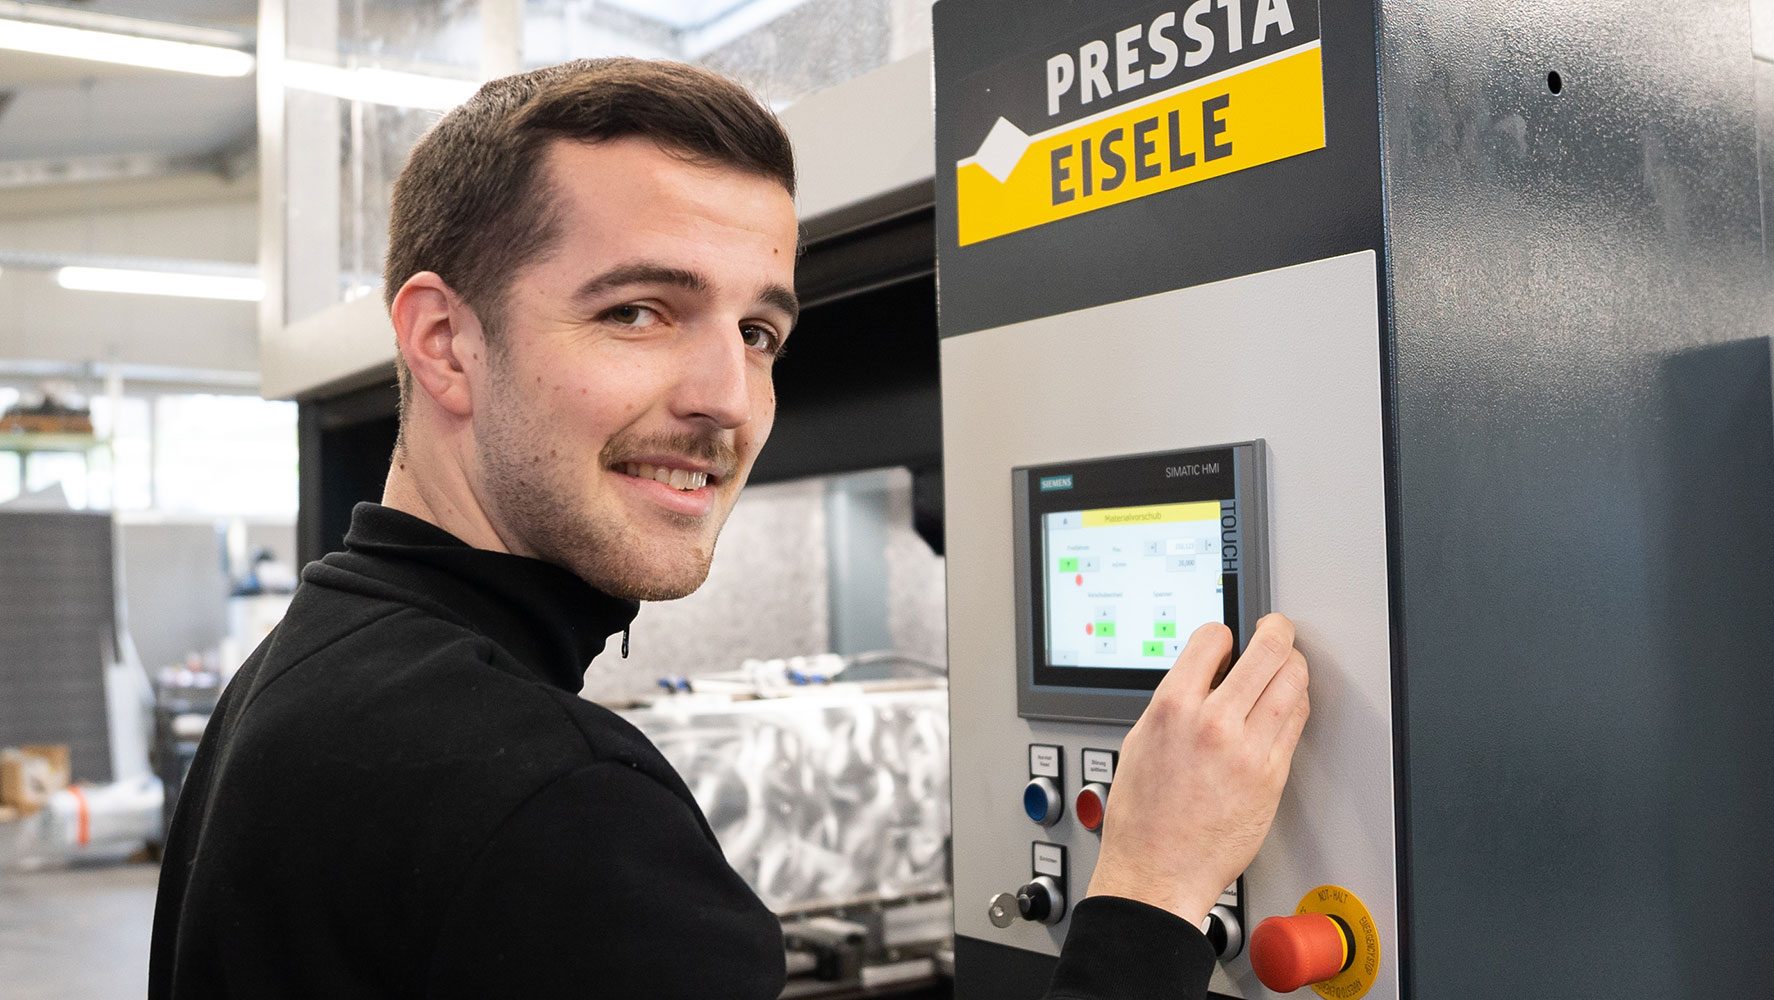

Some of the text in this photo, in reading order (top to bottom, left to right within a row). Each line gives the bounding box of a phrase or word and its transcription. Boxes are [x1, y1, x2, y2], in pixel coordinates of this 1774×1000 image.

[1047, 0, 1295, 116] PRESSTA
[1050, 93, 1233, 207] EISELE
[1041, 477, 1072, 490] SIEMENS
[1165, 462, 1220, 478] SIMATIC HMI
[1104, 512, 1162, 523] Materialvorschub
[1220, 501, 1238, 571] TOUCH
[1359, 915, 1376, 976] EMERGENCY STOP
